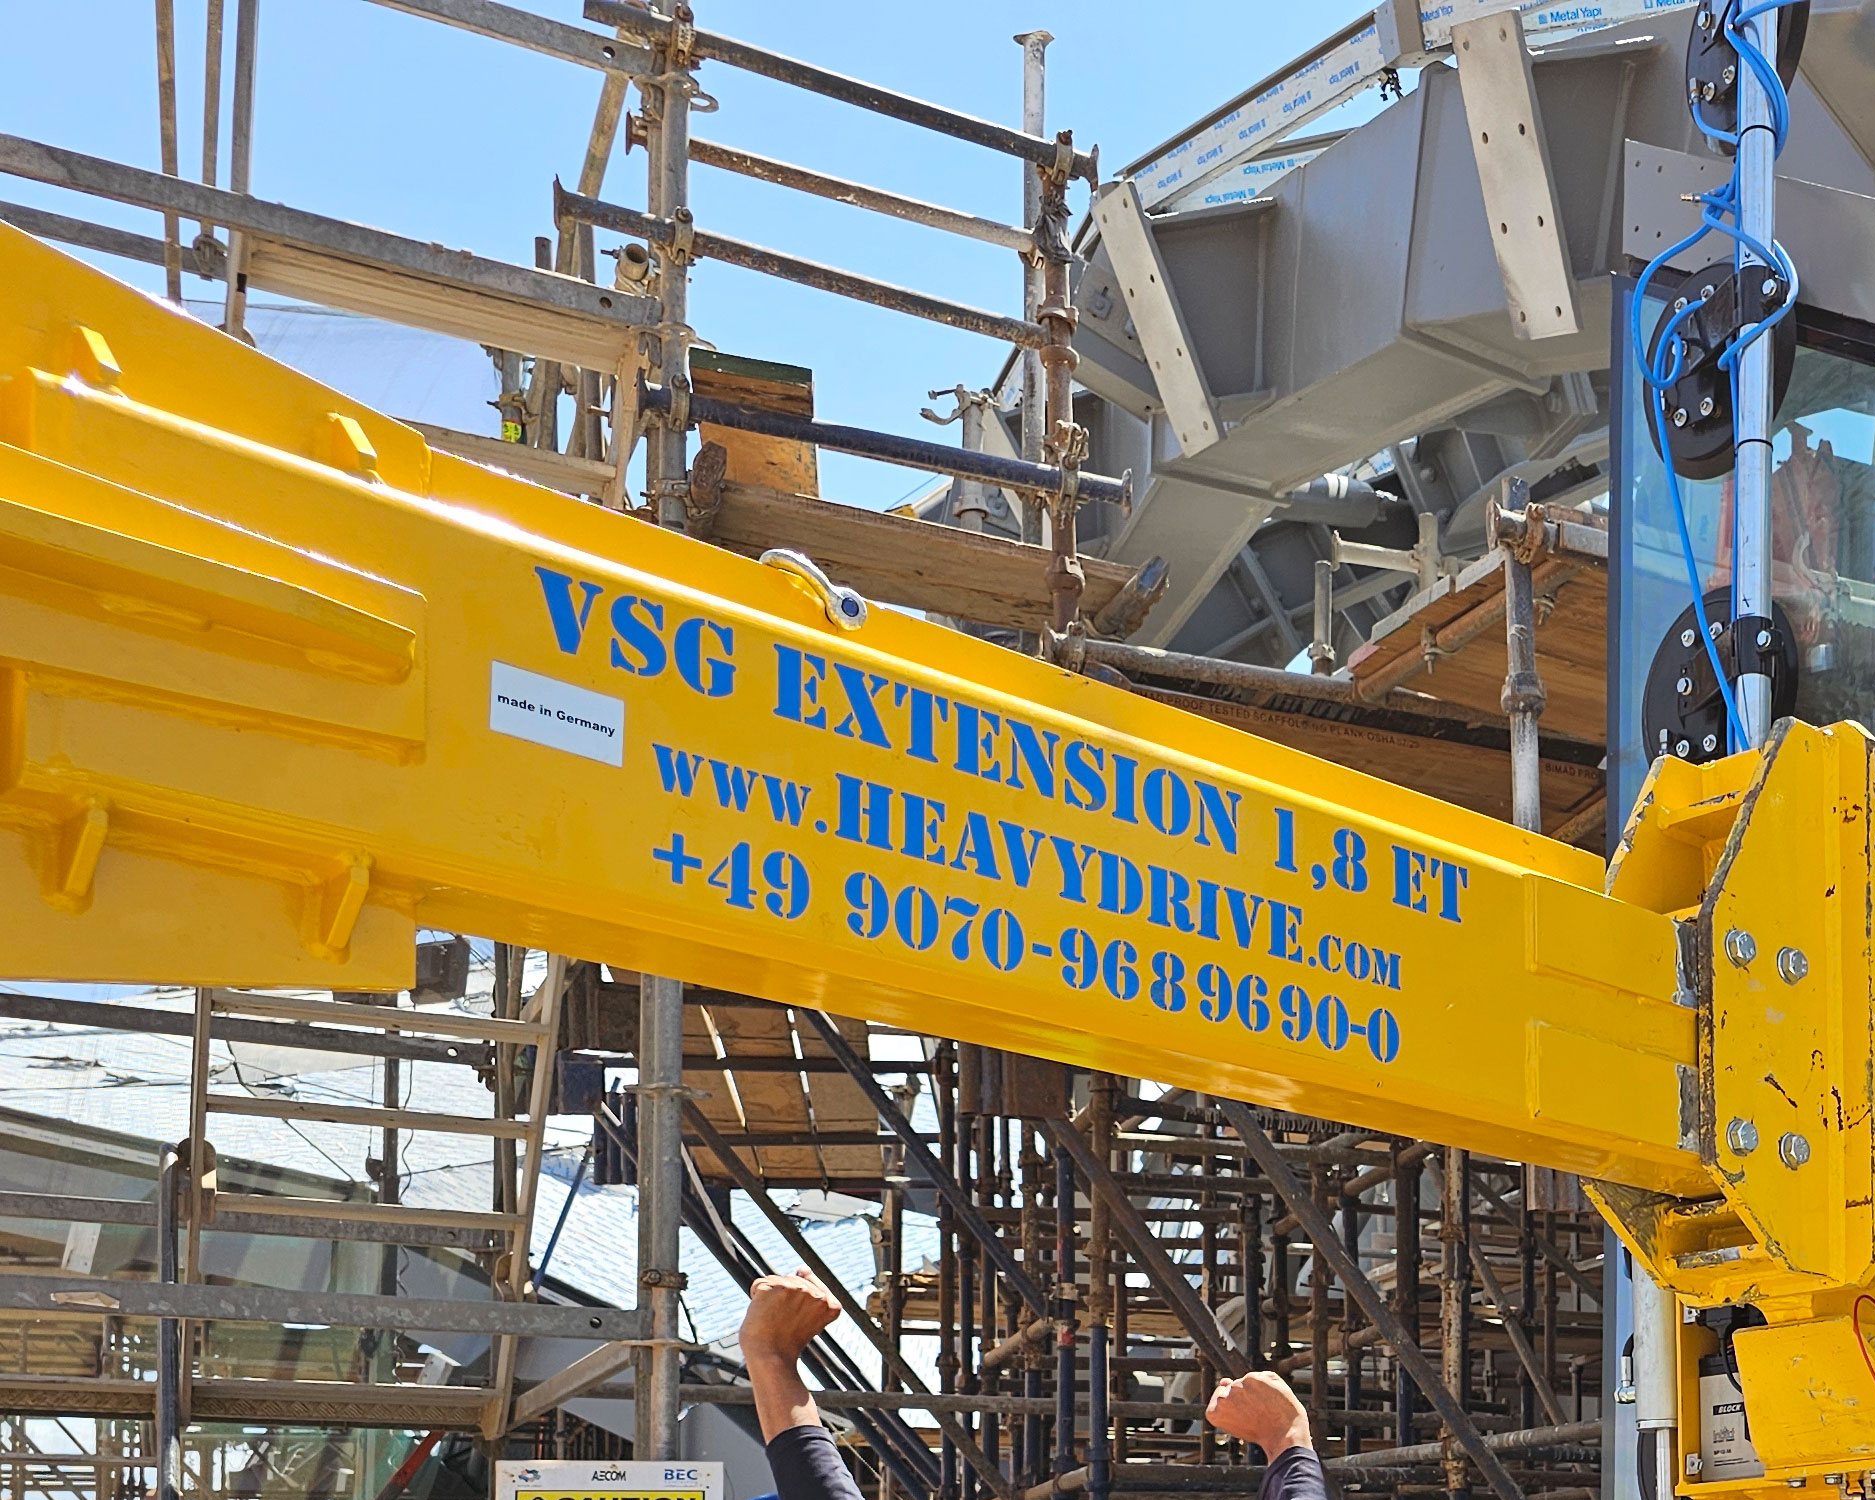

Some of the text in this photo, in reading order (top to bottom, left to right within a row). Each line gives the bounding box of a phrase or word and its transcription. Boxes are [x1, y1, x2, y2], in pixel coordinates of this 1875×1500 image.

[1550, 8, 1579, 22] Metal
[497, 694, 616, 738] made in Germany
[1210, 703, 1250, 720] TESTED
[1329, 724, 1364, 739] PLANK
[1367, 730, 1396, 745] OSHA
[535, 566, 1470, 924] VSG EXTENSION 1,8 ET
[652, 833, 1402, 1063] +49 9070-9689690-0
[1718, 1404, 1742, 1414] BLOCK
[591, 1471, 627, 1481] AECOM
[664, 1469, 698, 1481] BEC
